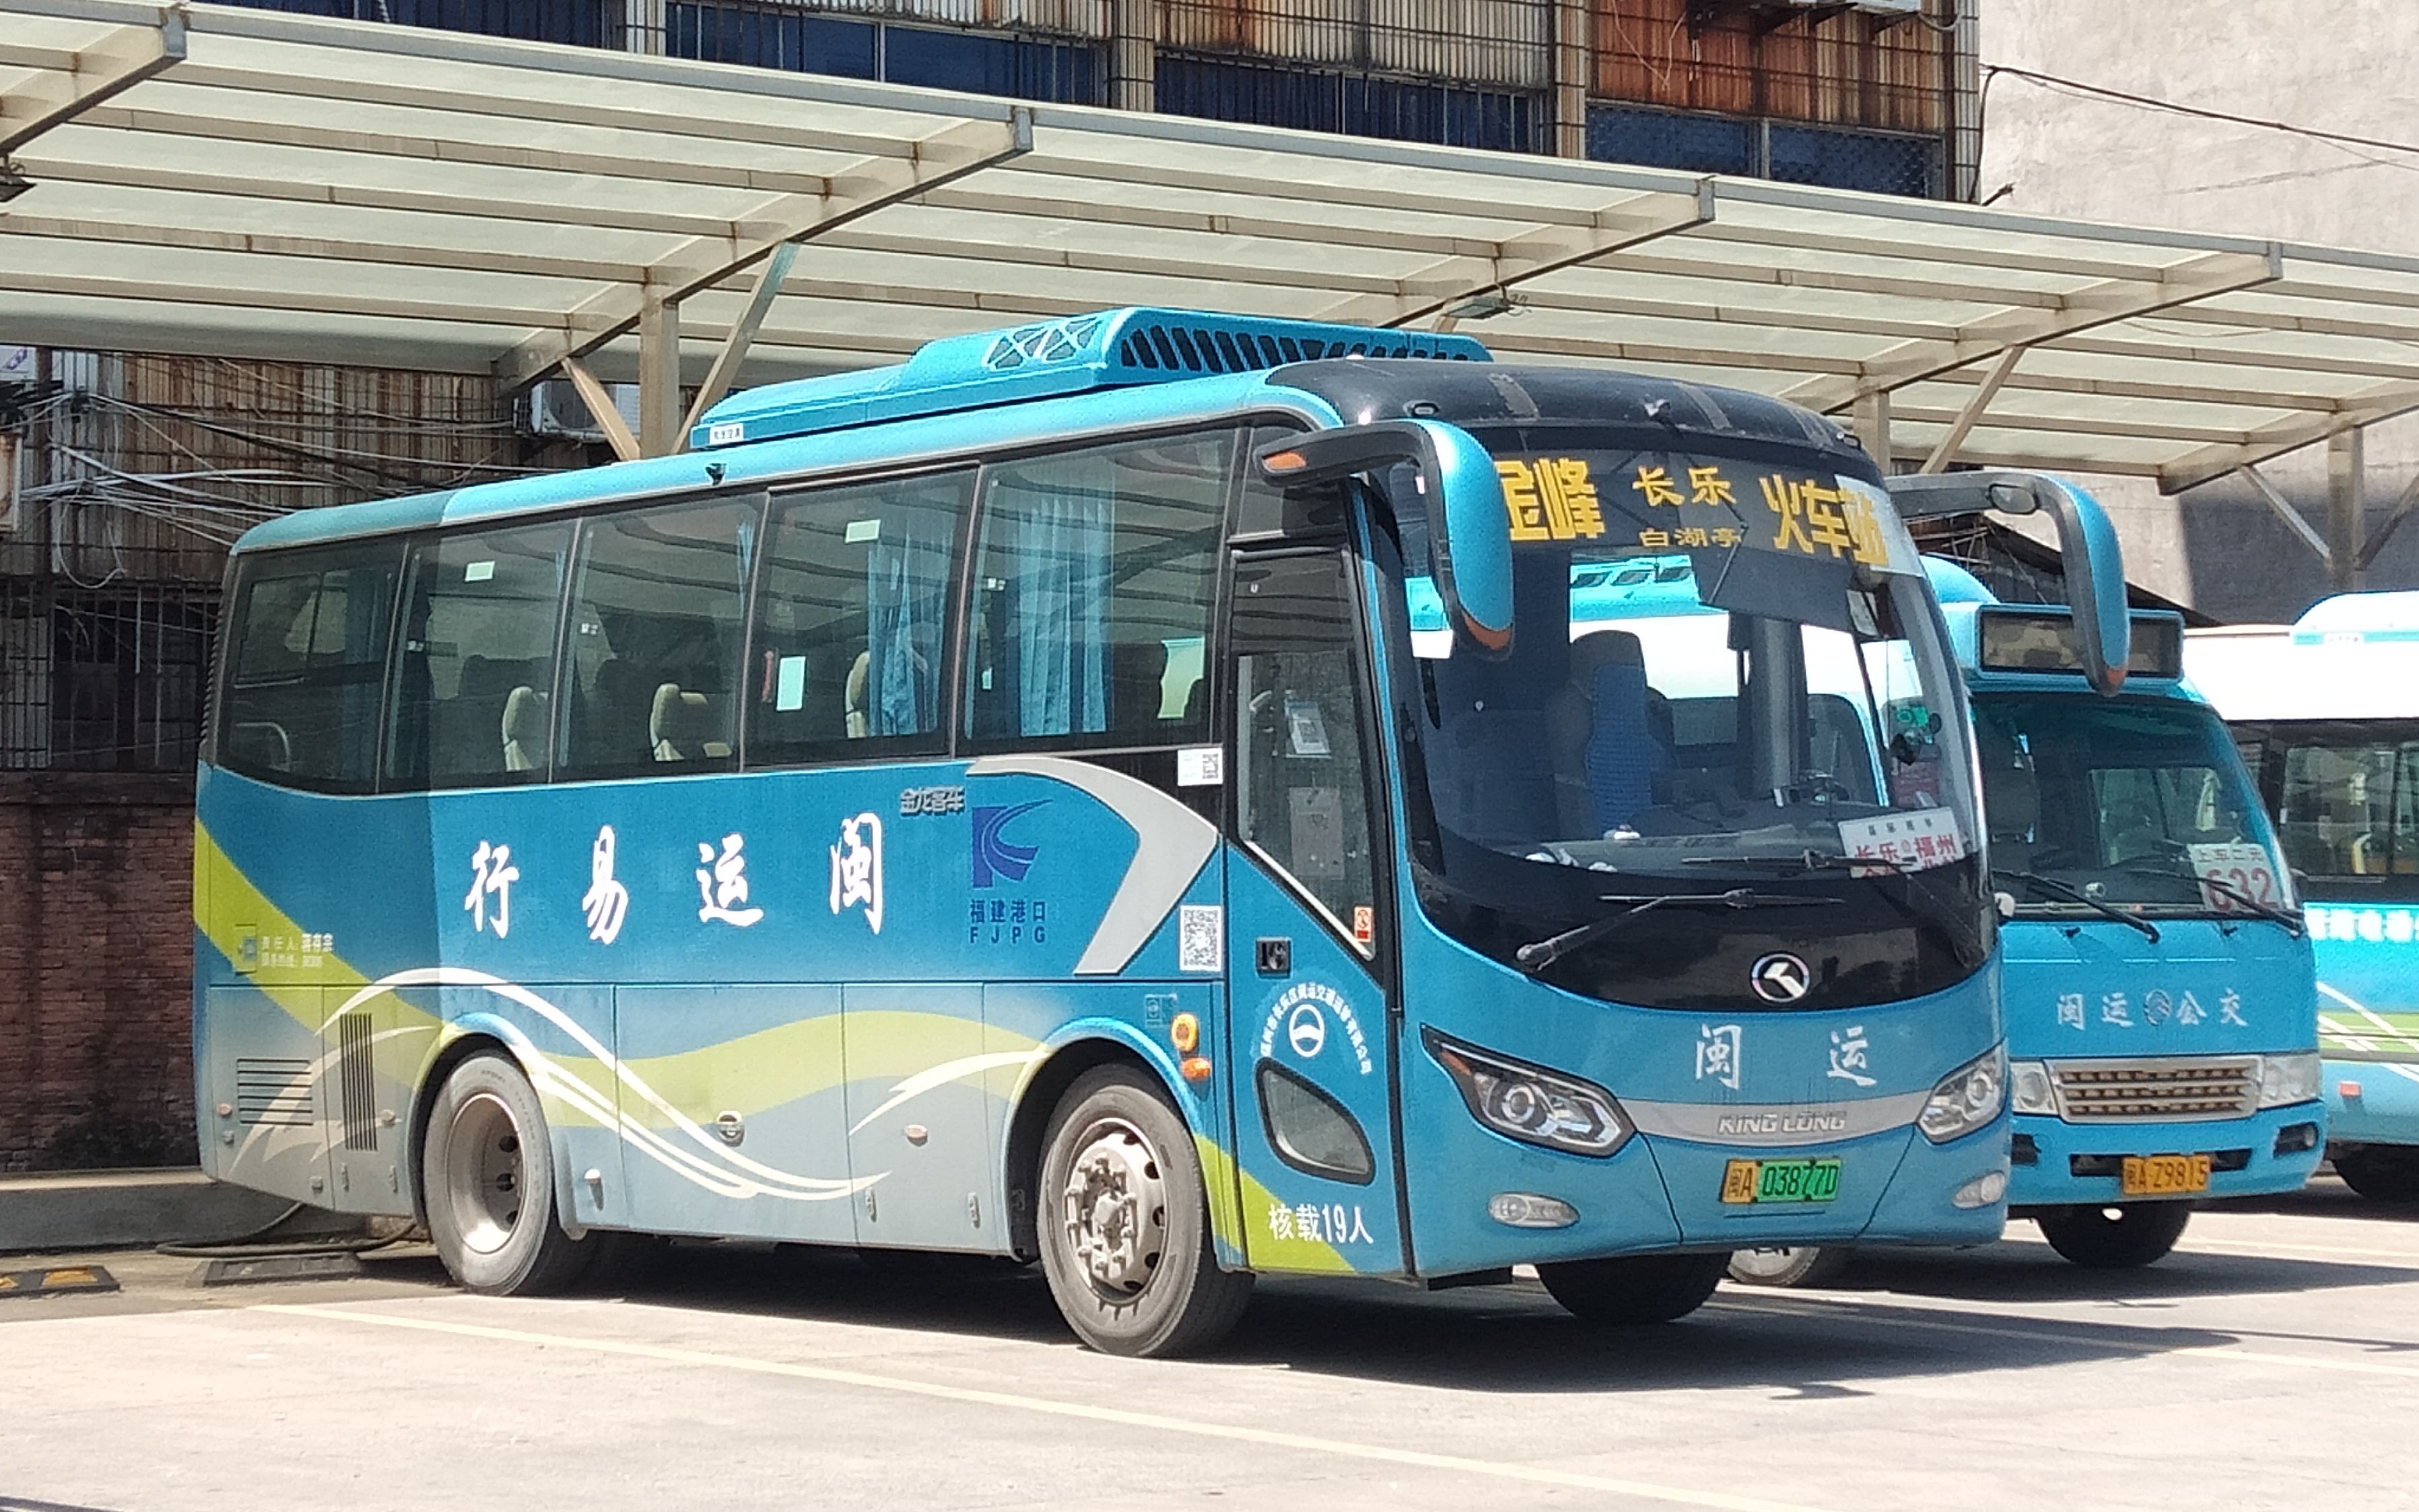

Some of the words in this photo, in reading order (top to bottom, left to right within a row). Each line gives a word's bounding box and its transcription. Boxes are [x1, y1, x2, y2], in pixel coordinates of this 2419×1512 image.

[1494, 458, 1606, 541] 金峰
[1632, 465, 1737, 506] 长乐
[1639, 527, 1742, 548] 白湖亭
[1759, 473, 1889, 566] 火车站
[900, 785, 964, 816] 金龙客车
[1914, 834, 1957, 857] 福州
[970, 899, 1046, 924] 福建港口
[970, 926, 1046, 944] FJPG
[2057, 991, 2134, 1031] 闽运
[2176, 988, 2248, 1027] 公交
[1695, 1023, 1877, 1089] 闽运
[1718, 1114, 1778, 1134] KING
[1782, 1111, 1847, 1132] LONG
[1268, 1203, 1374, 1244] 核载19人
